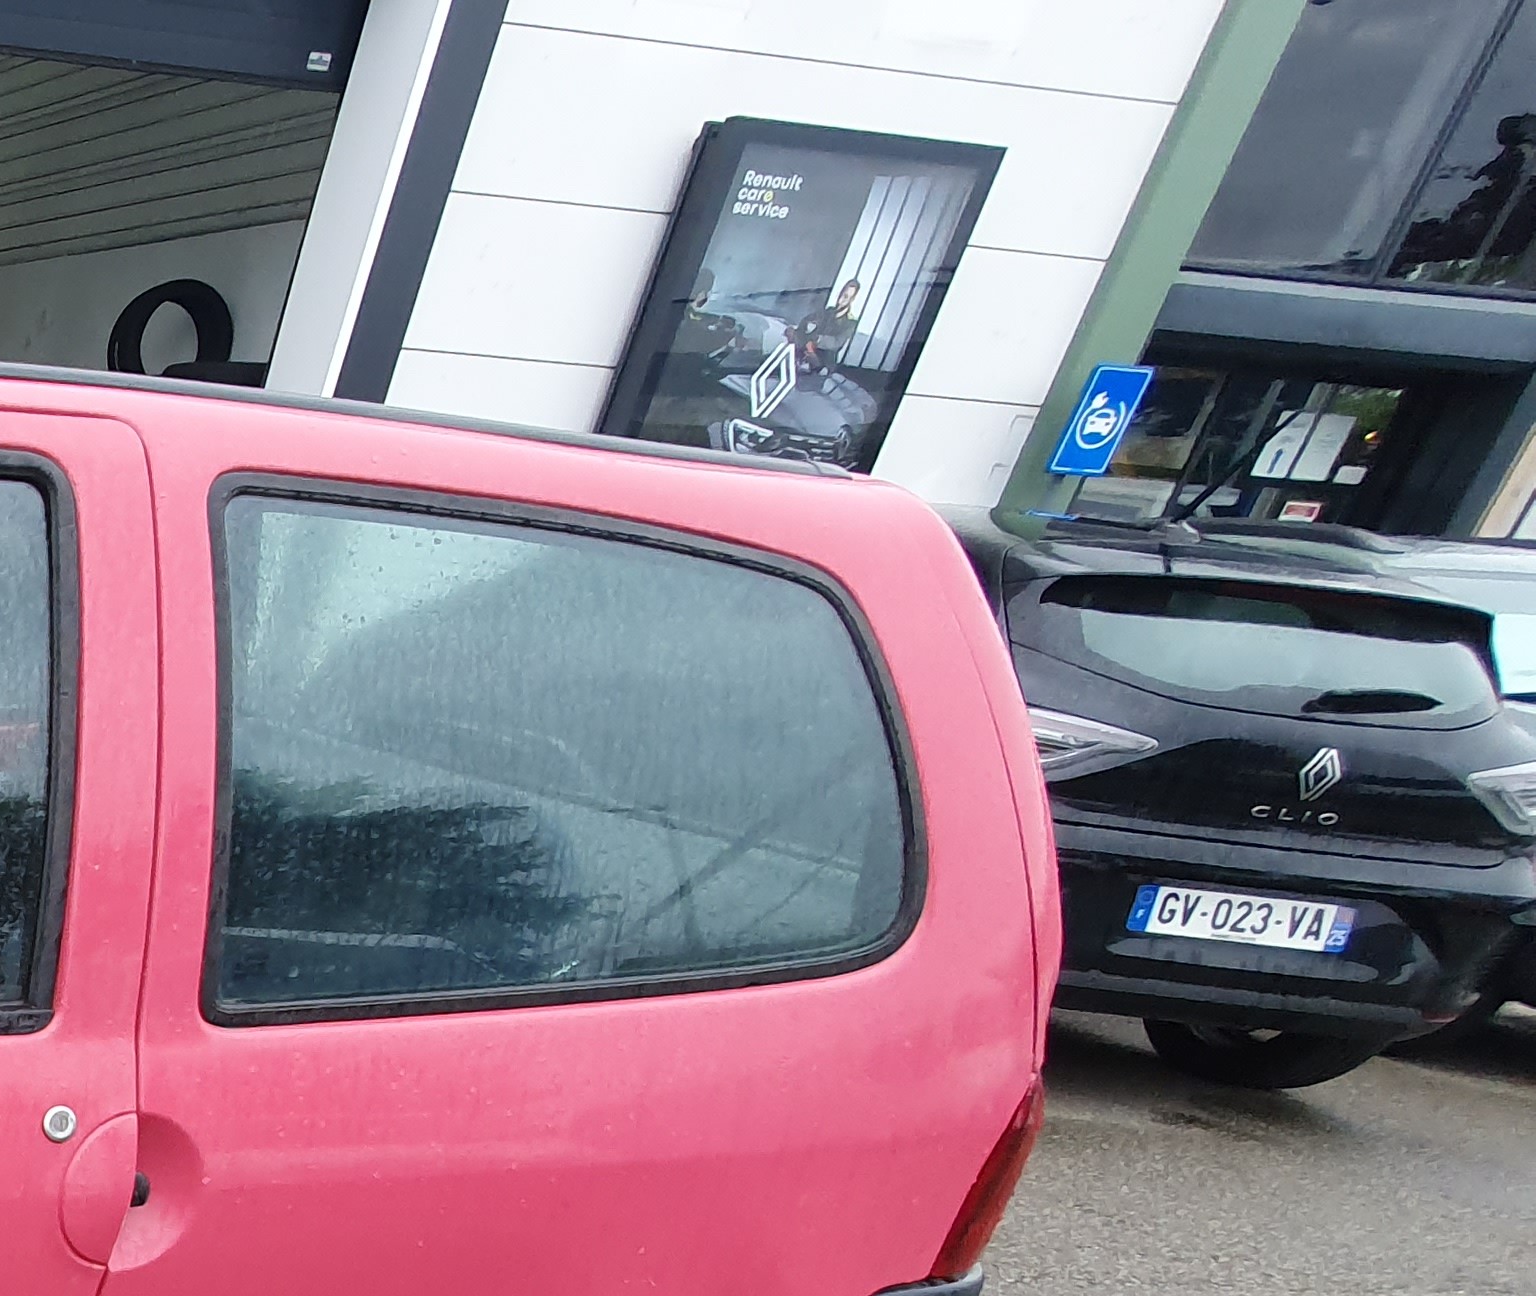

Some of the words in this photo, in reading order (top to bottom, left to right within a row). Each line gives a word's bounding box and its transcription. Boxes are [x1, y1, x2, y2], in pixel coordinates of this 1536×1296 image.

[742, 170, 803, 191] Renault
[737, 187, 774, 202] care
[732, 202, 789, 218] service
[1251, 805, 1339, 825] CLIO
[1157, 891, 1326, 942] GV-023-VA
